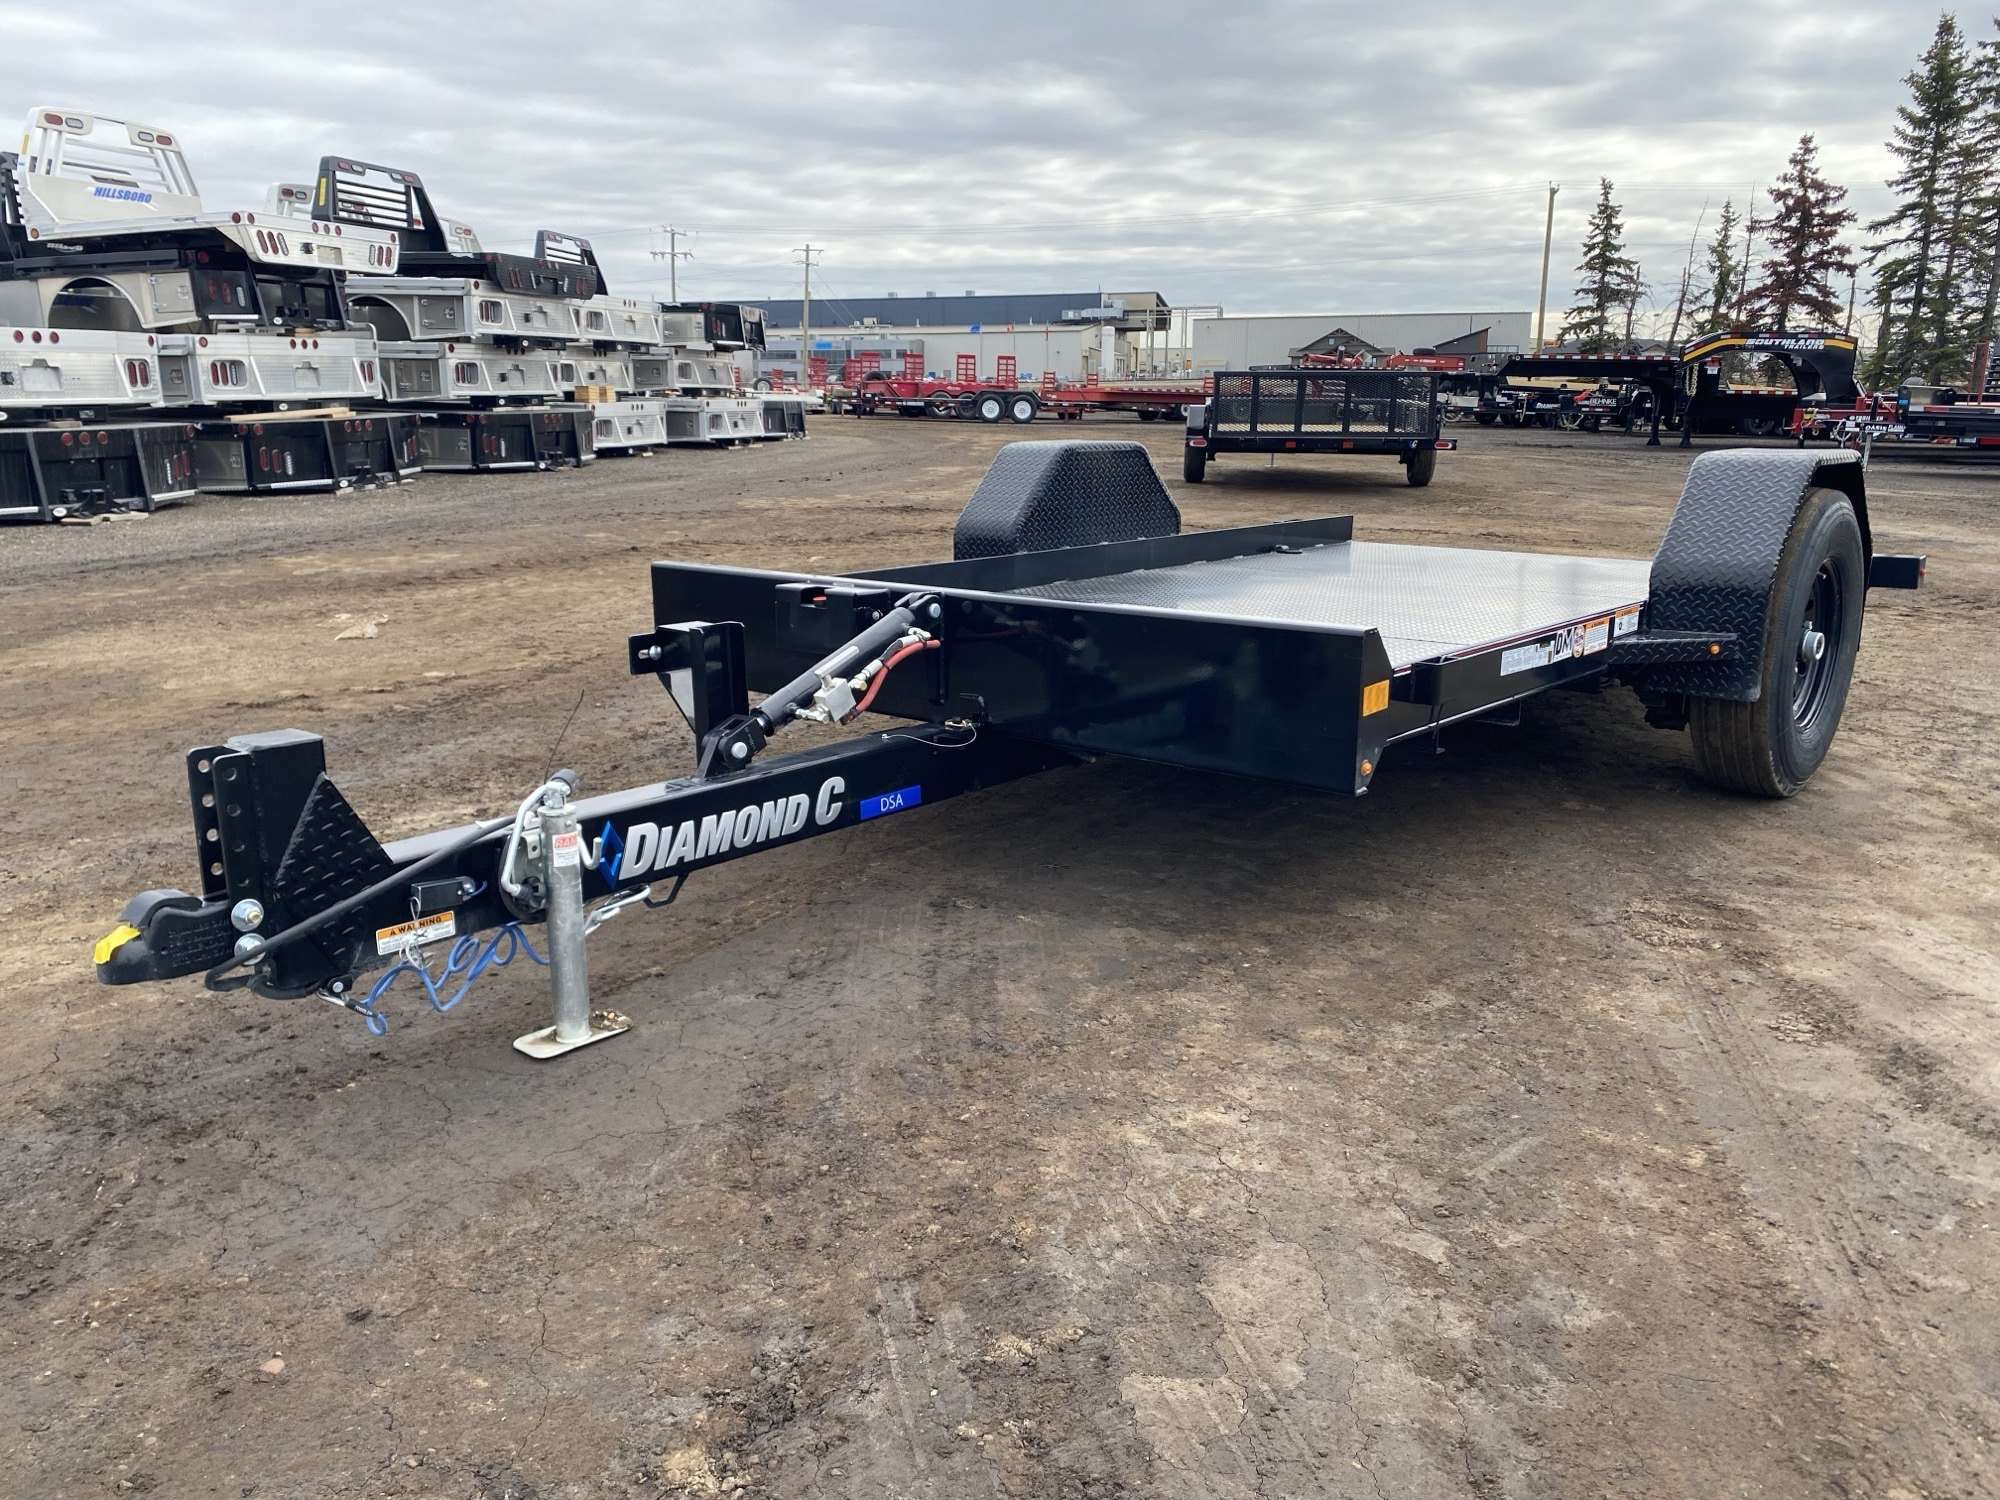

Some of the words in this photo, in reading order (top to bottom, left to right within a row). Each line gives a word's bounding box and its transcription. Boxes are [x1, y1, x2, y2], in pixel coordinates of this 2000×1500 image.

[94, 186, 153, 204] HILLSBORO
[1745, 338, 1825, 346] SOUTHLAND
[880, 793, 904, 812] DSA
[618, 793, 810, 881] DIAMOND
[814, 776, 846, 827] C
